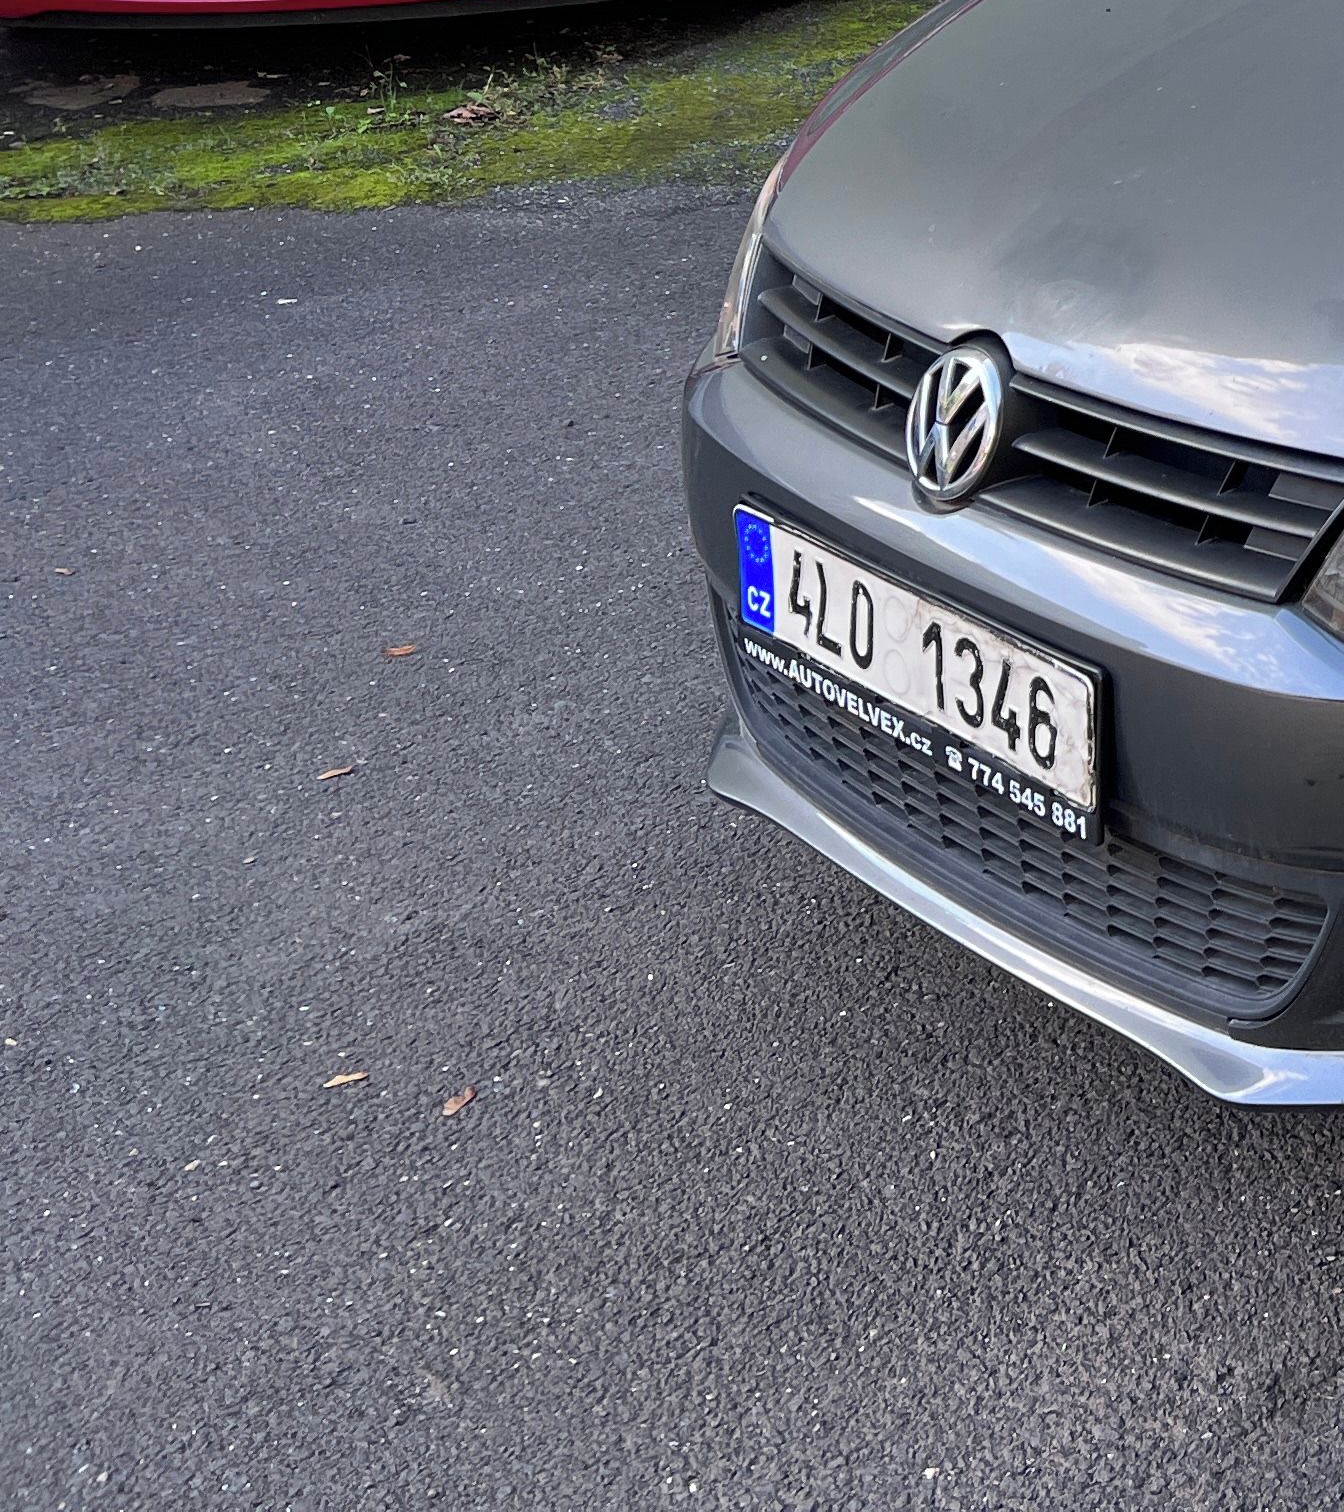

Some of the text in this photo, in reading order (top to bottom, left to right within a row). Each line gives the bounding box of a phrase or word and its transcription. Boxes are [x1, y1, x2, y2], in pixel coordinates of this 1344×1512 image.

[744, 637, 1087, 840] www.AUTOVELVEX.cz 774 545 881
[747, 549, 1058, 770] CZ 4L0 1346
